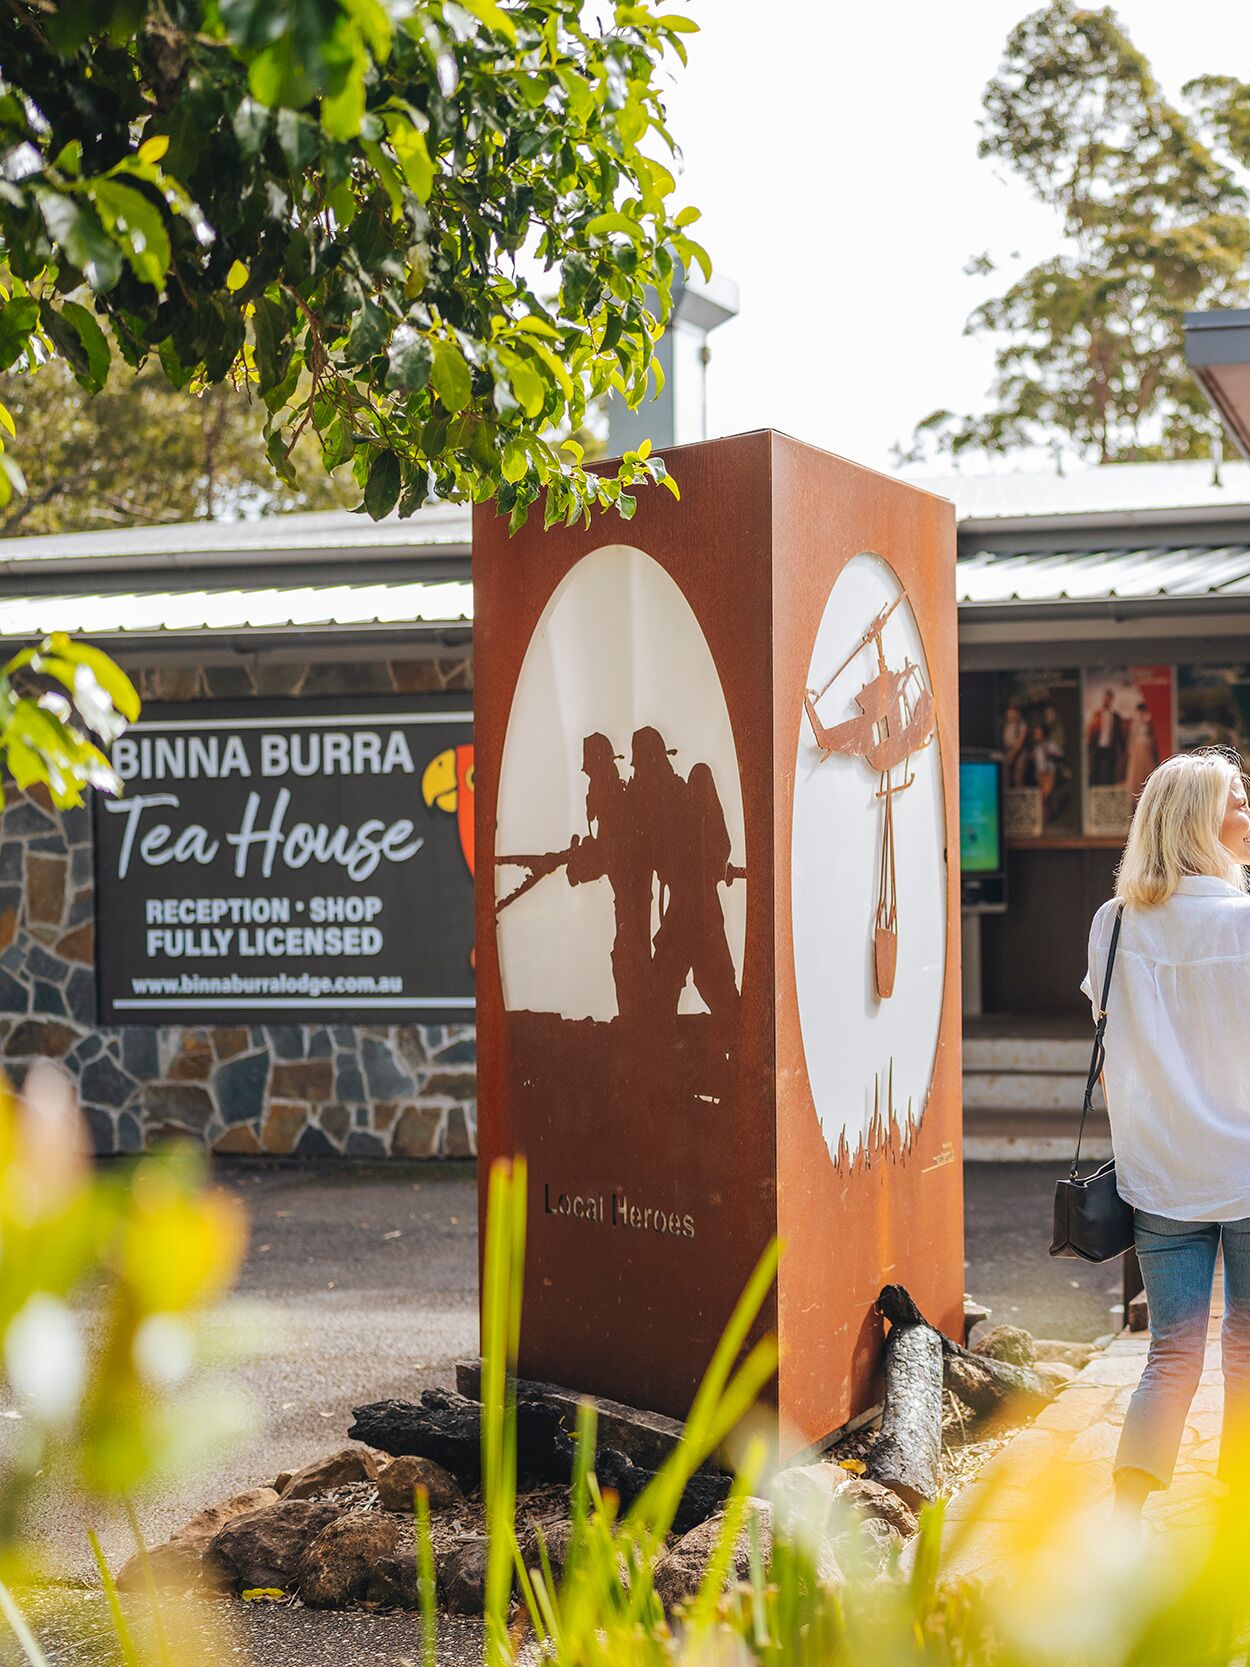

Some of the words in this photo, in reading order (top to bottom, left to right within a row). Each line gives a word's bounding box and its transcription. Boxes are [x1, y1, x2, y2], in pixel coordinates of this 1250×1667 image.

[111, 734, 252, 780] BINNA
[260, 731, 416, 778] BURRA
[104, 792, 220, 880] Tea
[226, 787, 424, 882] House
[145, 897, 290, 925] RECEPTION
[309, 896, 383, 923] SHOP
[146, 928, 234, 957] FULLY
[239, 926, 384, 957] LICENSED
[131, 972, 403, 998] www.binnaburralodge.com.au
[544, 1182, 604, 1224] Local
[611, 1193, 696, 1239] Heroes
